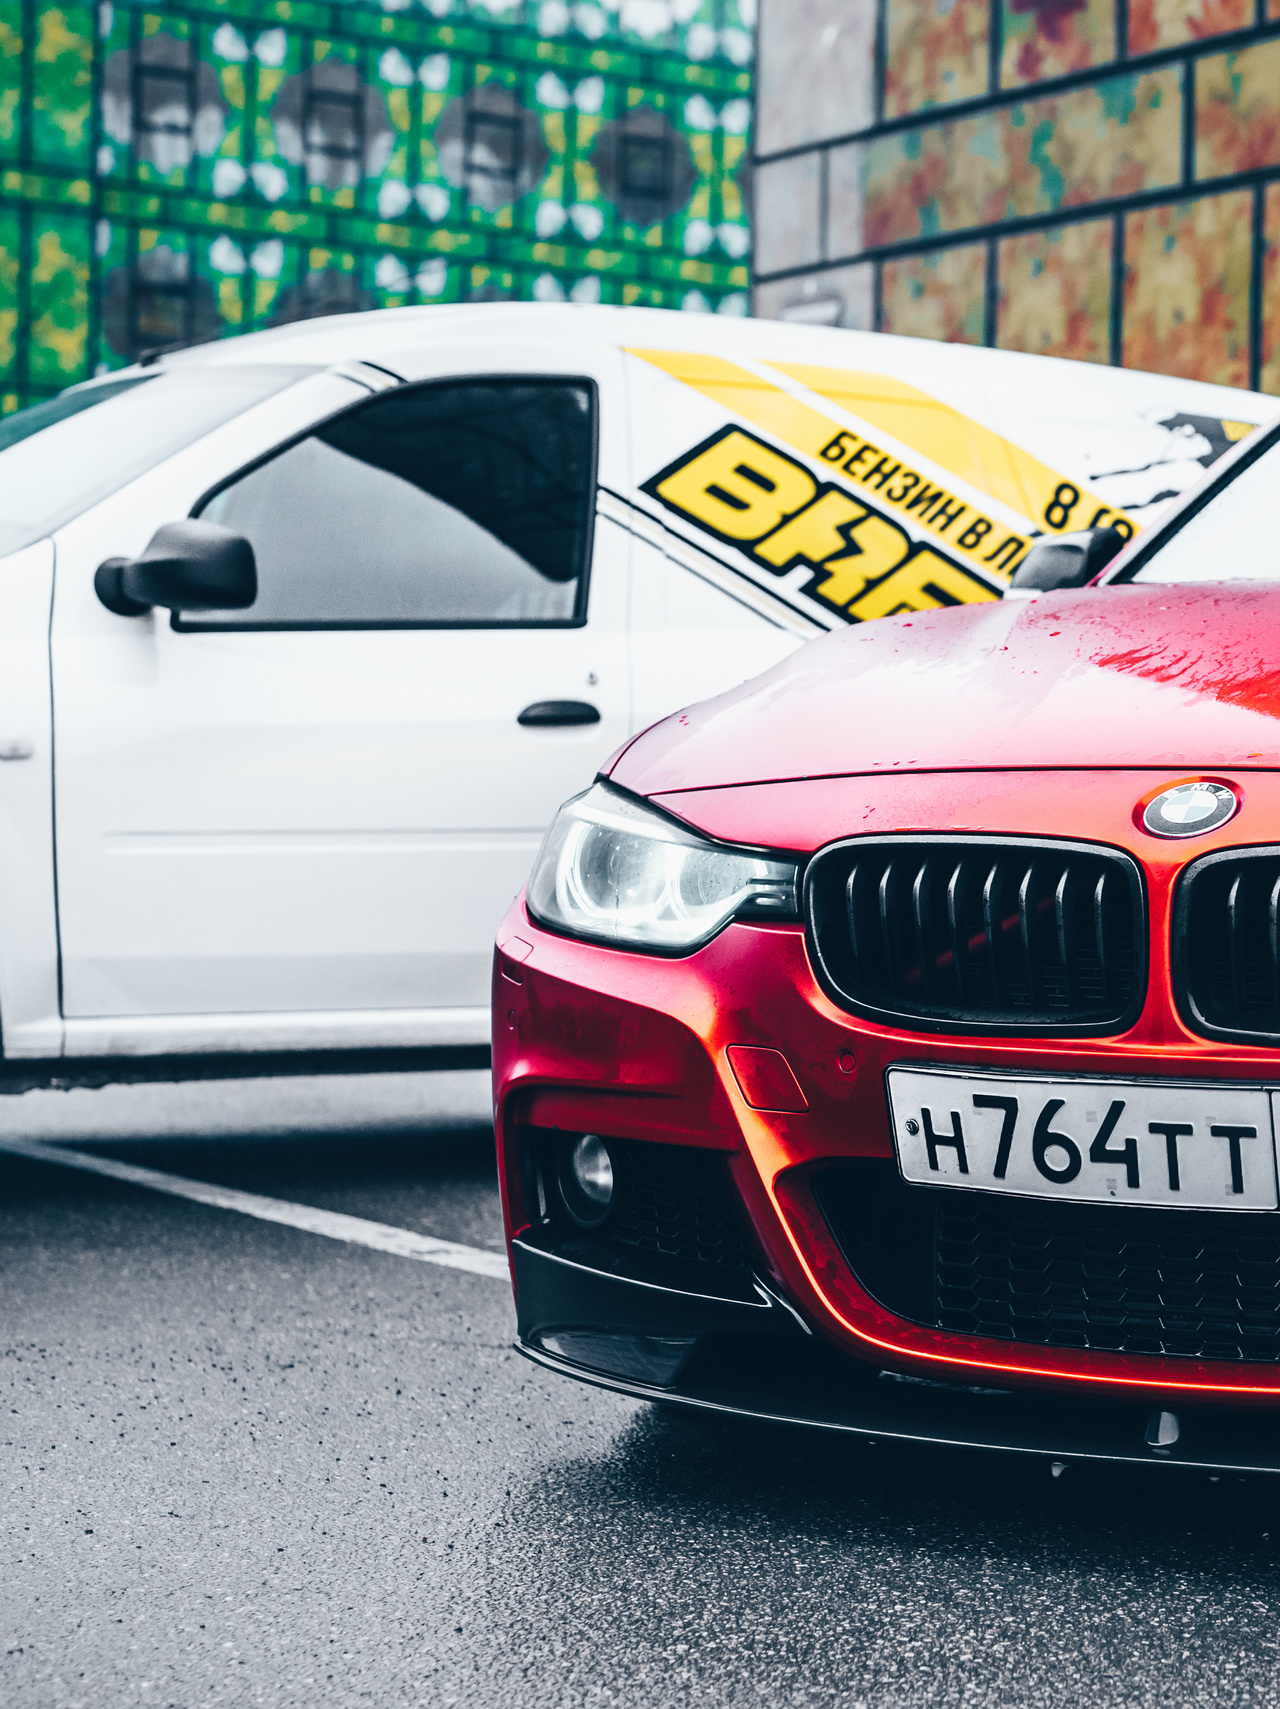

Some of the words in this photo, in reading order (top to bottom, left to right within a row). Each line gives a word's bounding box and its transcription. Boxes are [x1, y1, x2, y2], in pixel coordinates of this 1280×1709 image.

[819, 431, 967, 533] БЕНЗИН
[957, 517, 992, 549] В
[1045, 482, 1080, 530] 8
[1162, 783, 1233, 800] BMW
